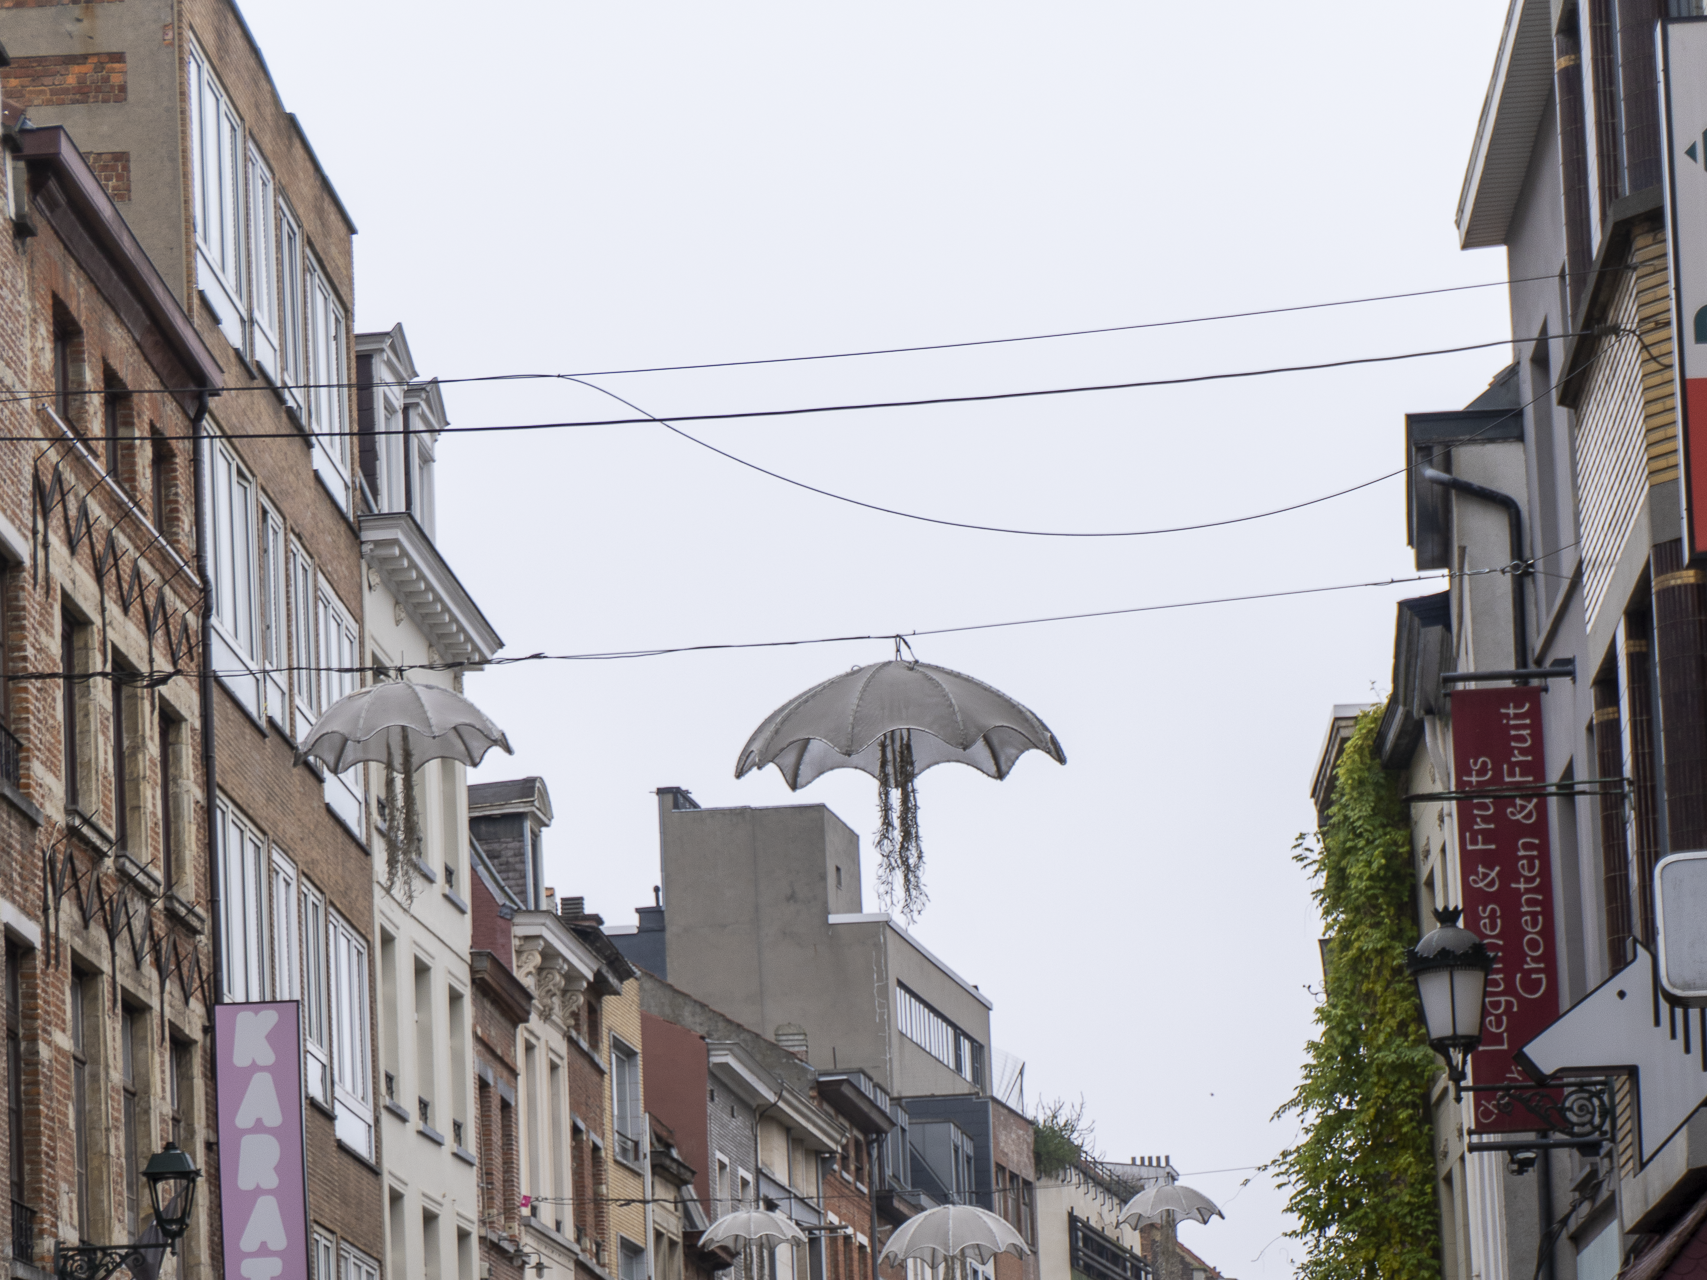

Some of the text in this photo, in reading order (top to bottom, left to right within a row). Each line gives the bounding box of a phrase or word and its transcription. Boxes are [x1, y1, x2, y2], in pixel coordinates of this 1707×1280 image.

[1462, 756, 1497, 850] Fruts
[1500, 701, 1547, 998] Groenten & Fruit
[1469, 867, 1501, 891] &
